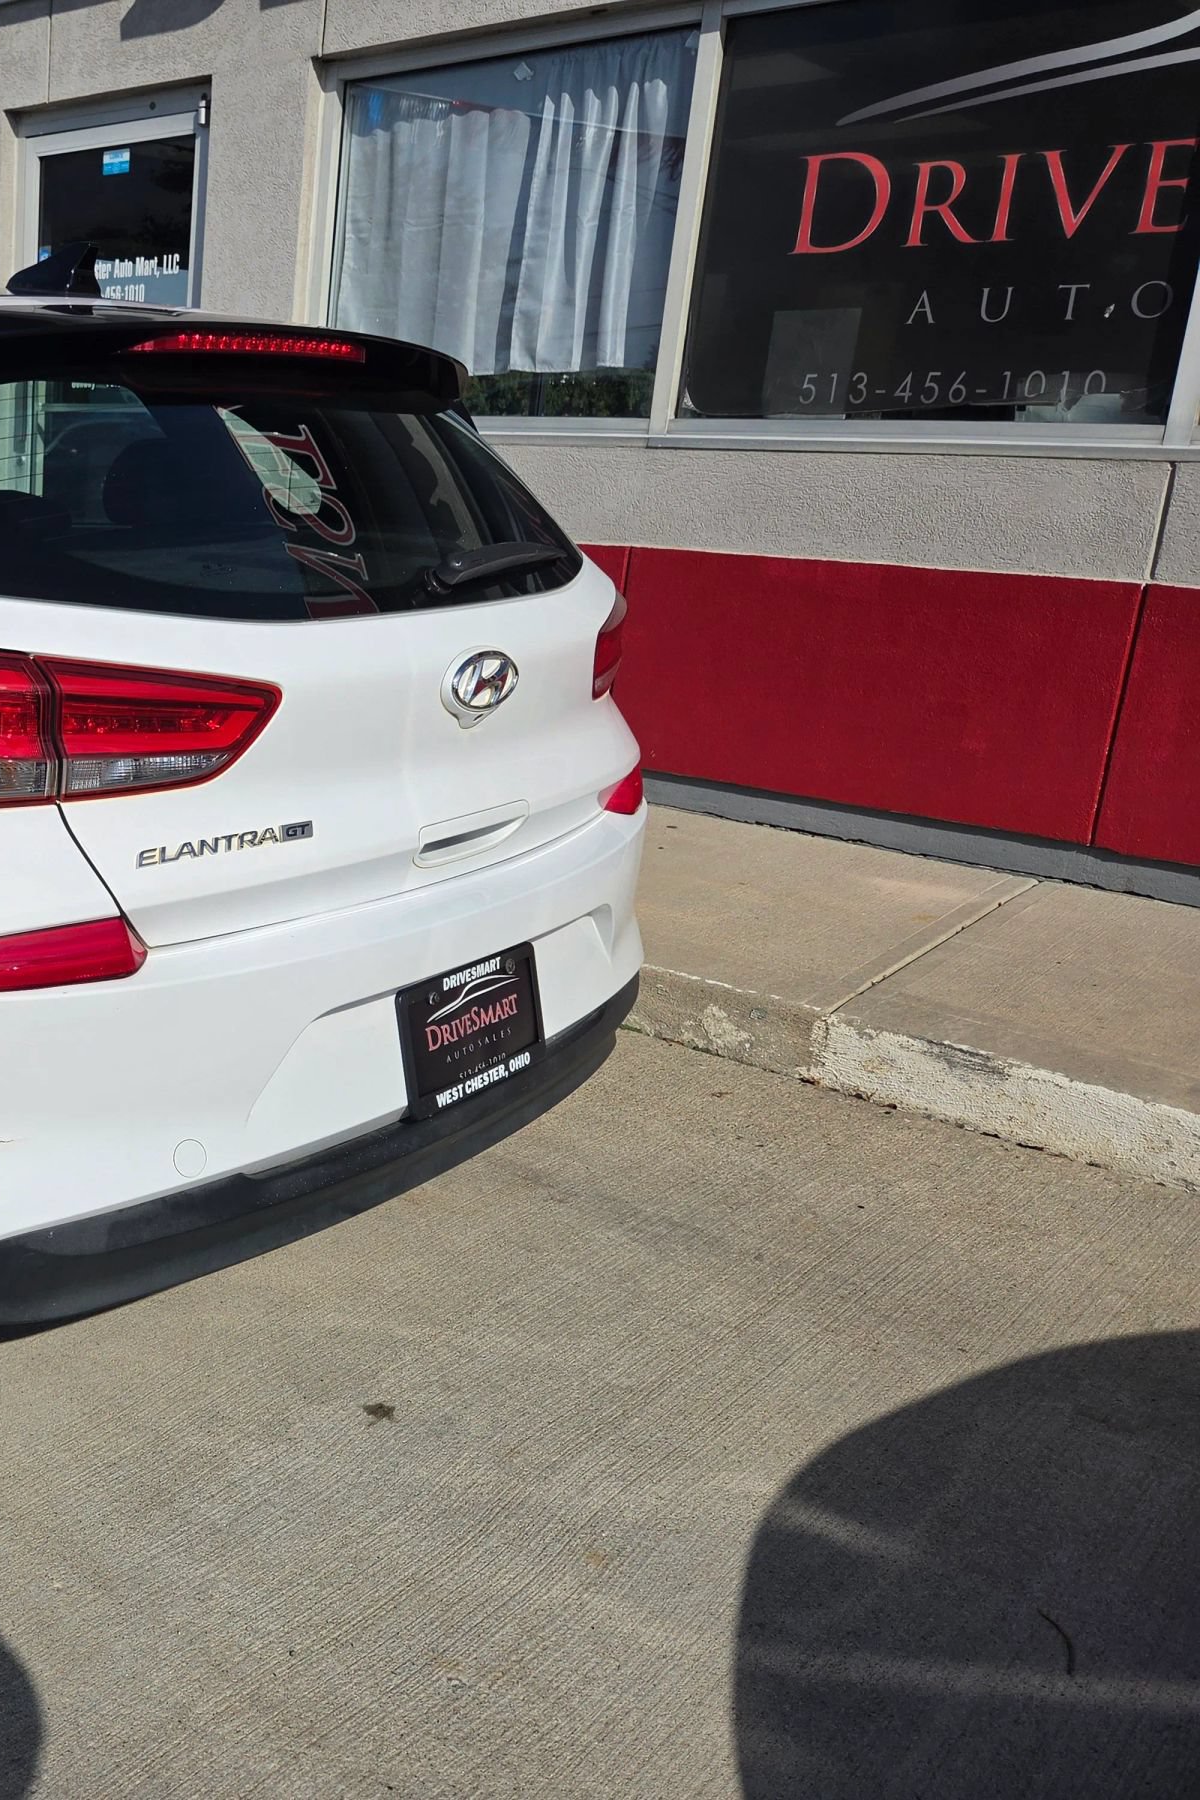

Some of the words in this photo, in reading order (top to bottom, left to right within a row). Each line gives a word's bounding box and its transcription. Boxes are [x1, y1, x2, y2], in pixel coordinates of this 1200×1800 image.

[787, 138, 1199, 255] DRIVE
[113, 258, 133, 279] Auto
[135, 256, 160, 279] Mart,
[163, 253, 180, 275] LLC
[905, 280, 1173, 325] AUTO
[799, 369, 1107, 405] 513-456-1010
[136, 827, 280, 869] ELANTRA
[285, 822, 311, 838] GT
[442, 957, 502, 992] DRIVESMART
[435, 1083, 464, 1109] WEST
[464, 1064, 509, 1096] CHESTER,
[509, 1051, 531, 1073] OHIO
